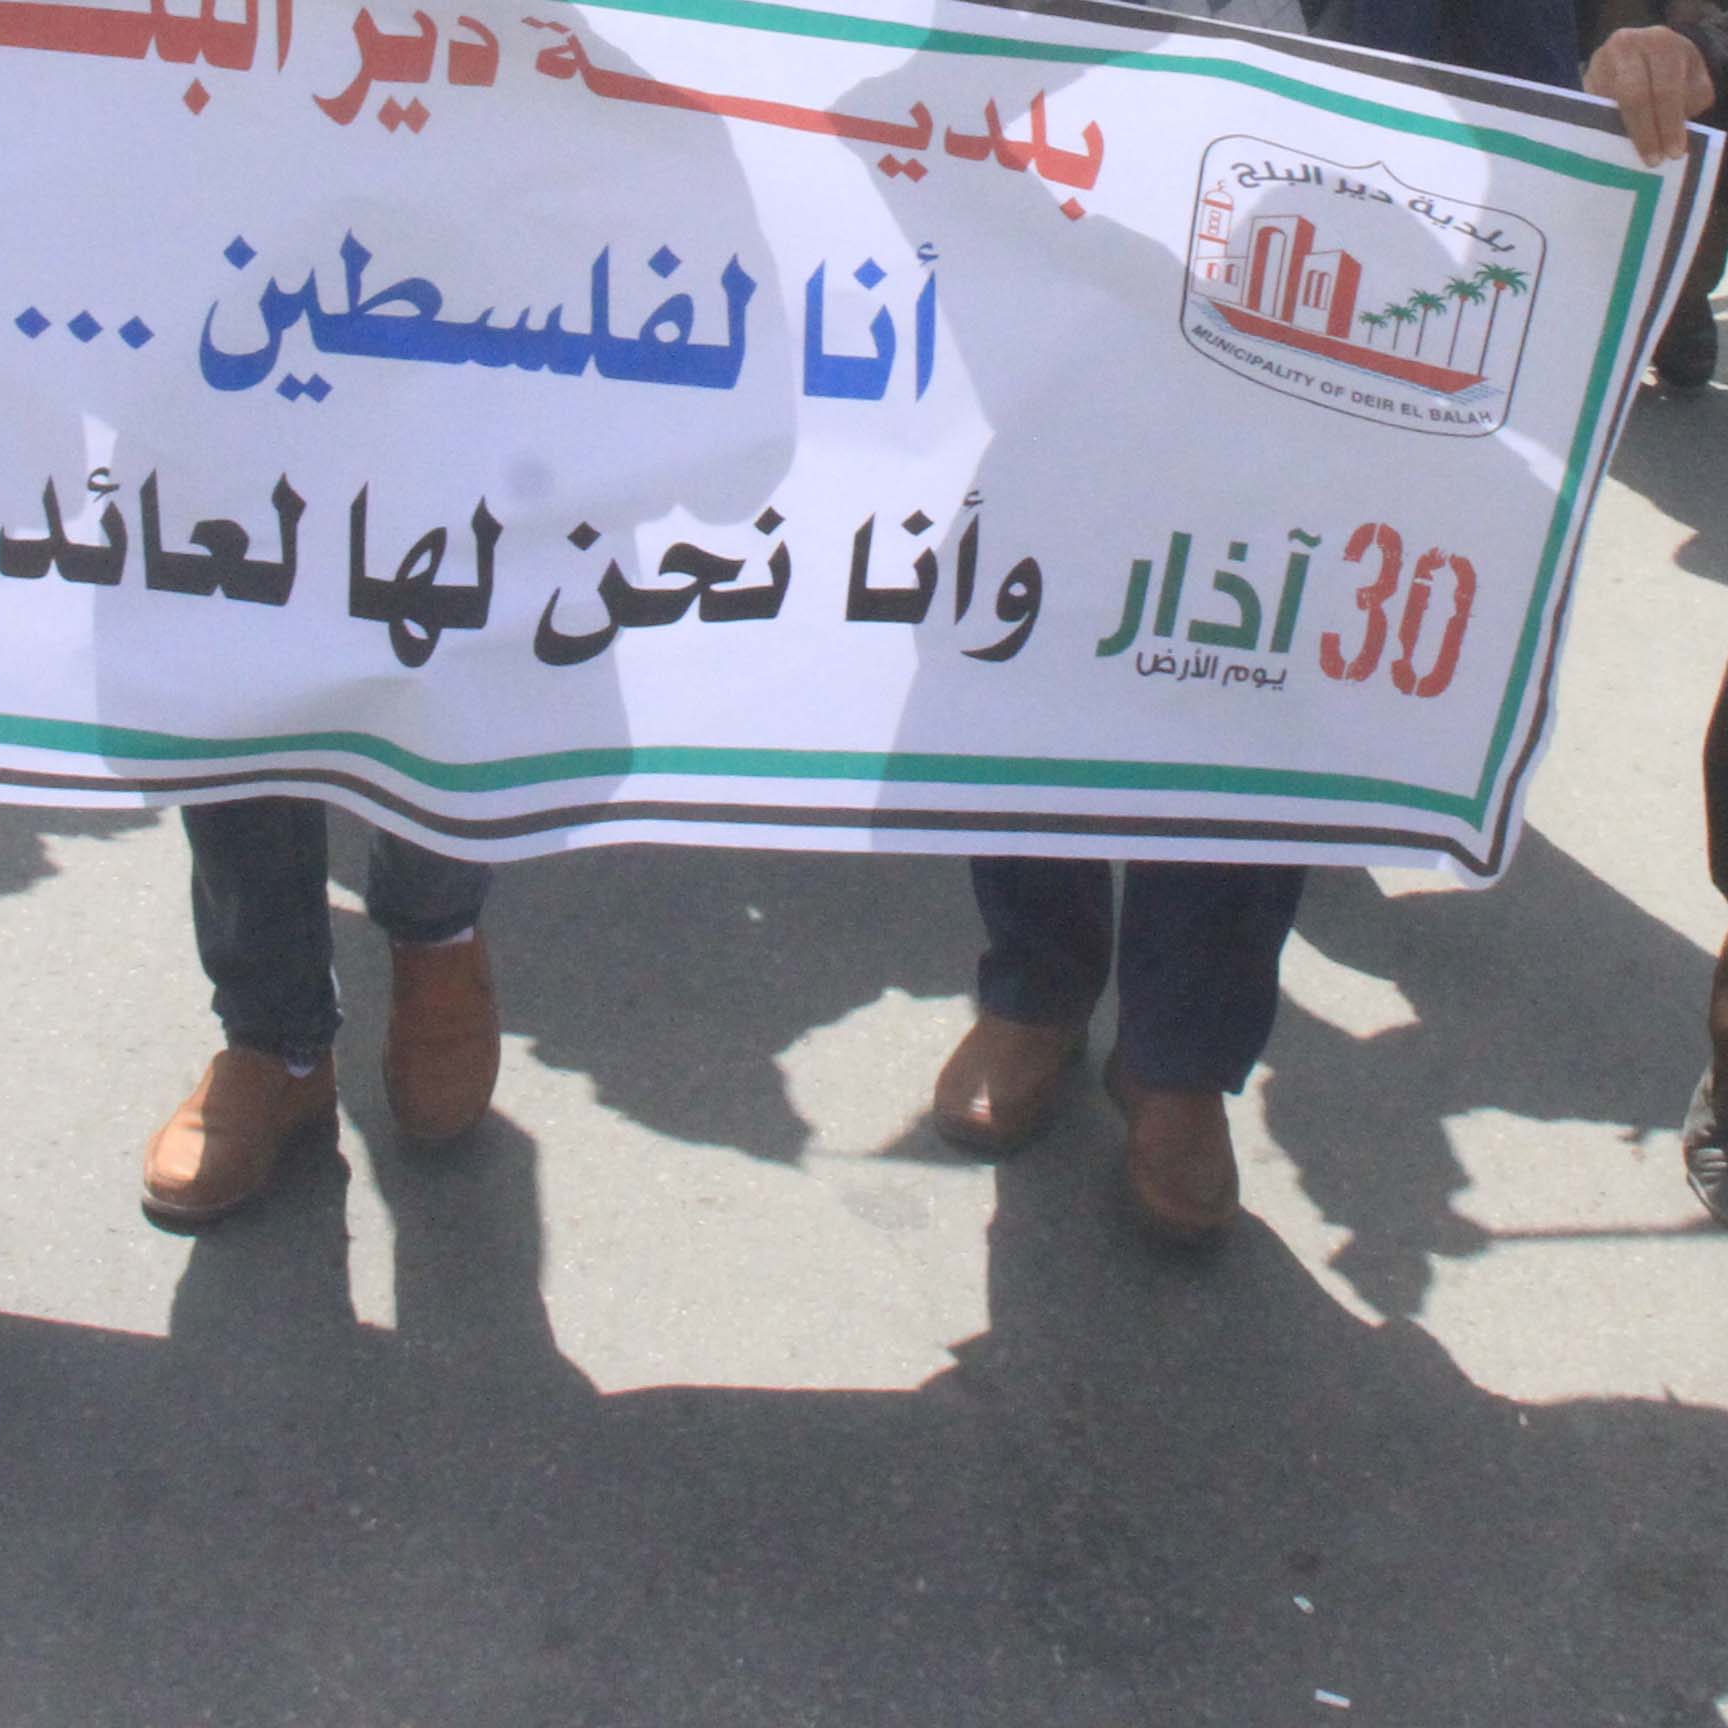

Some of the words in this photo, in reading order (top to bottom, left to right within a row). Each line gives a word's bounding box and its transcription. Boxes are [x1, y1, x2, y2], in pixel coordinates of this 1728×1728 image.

[312, 6, 501, 134] دير
[1231, 160, 1323, 189] البلح
[1334, 177, 1394, 204] دير
[1408, 195, 1516, 253] بلدية
[198, 228, 757, 405] لفلسطين
[803, 241, 940, 404] أنا
[1191, 324, 1315, 389] MUNICIPALITY
[1320, 380, 1347, 398] OF
[1351, 390, 1396, 413] DEIR
[1401, 403, 1423, 419] EL
[1428, 407, 1493, 425] BALAH
[348, 480, 503, 670] لها
[533, 505, 791, 667] نحن
[845, 489, 1044, 663] وأنا
[1094, 527, 1323, 657] آذار
[1319, 521, 1478, 699] 30
[1135, 647, 1218, 682] الأرض
[1222, 664, 1288, 692] يوم
